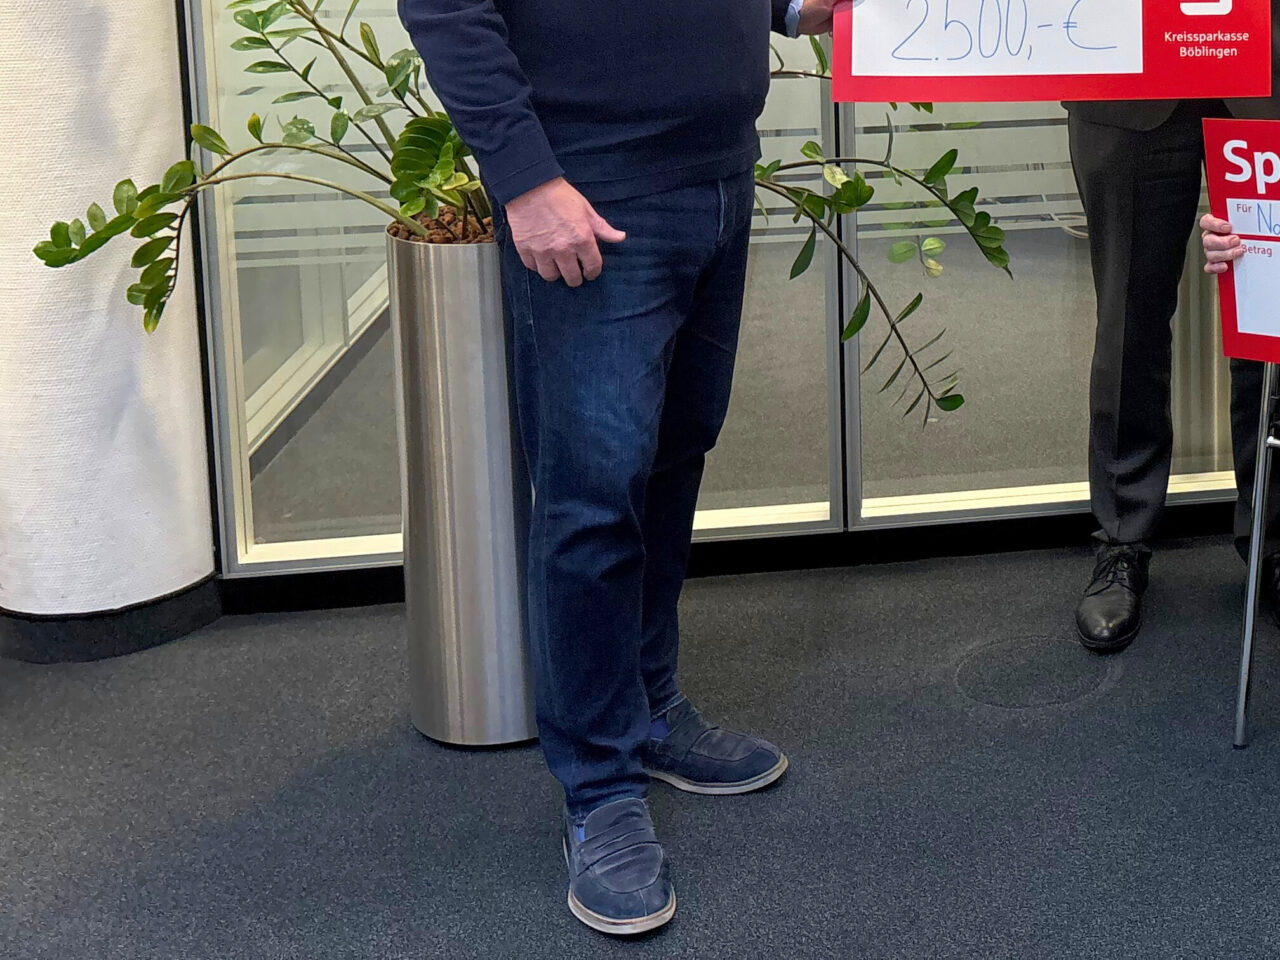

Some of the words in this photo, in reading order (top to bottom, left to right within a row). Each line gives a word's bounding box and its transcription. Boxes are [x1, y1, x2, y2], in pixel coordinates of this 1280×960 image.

[1164, 30, 1249, 44] Kreissparkasse
[1179, 46, 1237, 59] Böblingen
[1236, 203, 1252, 214] Für
